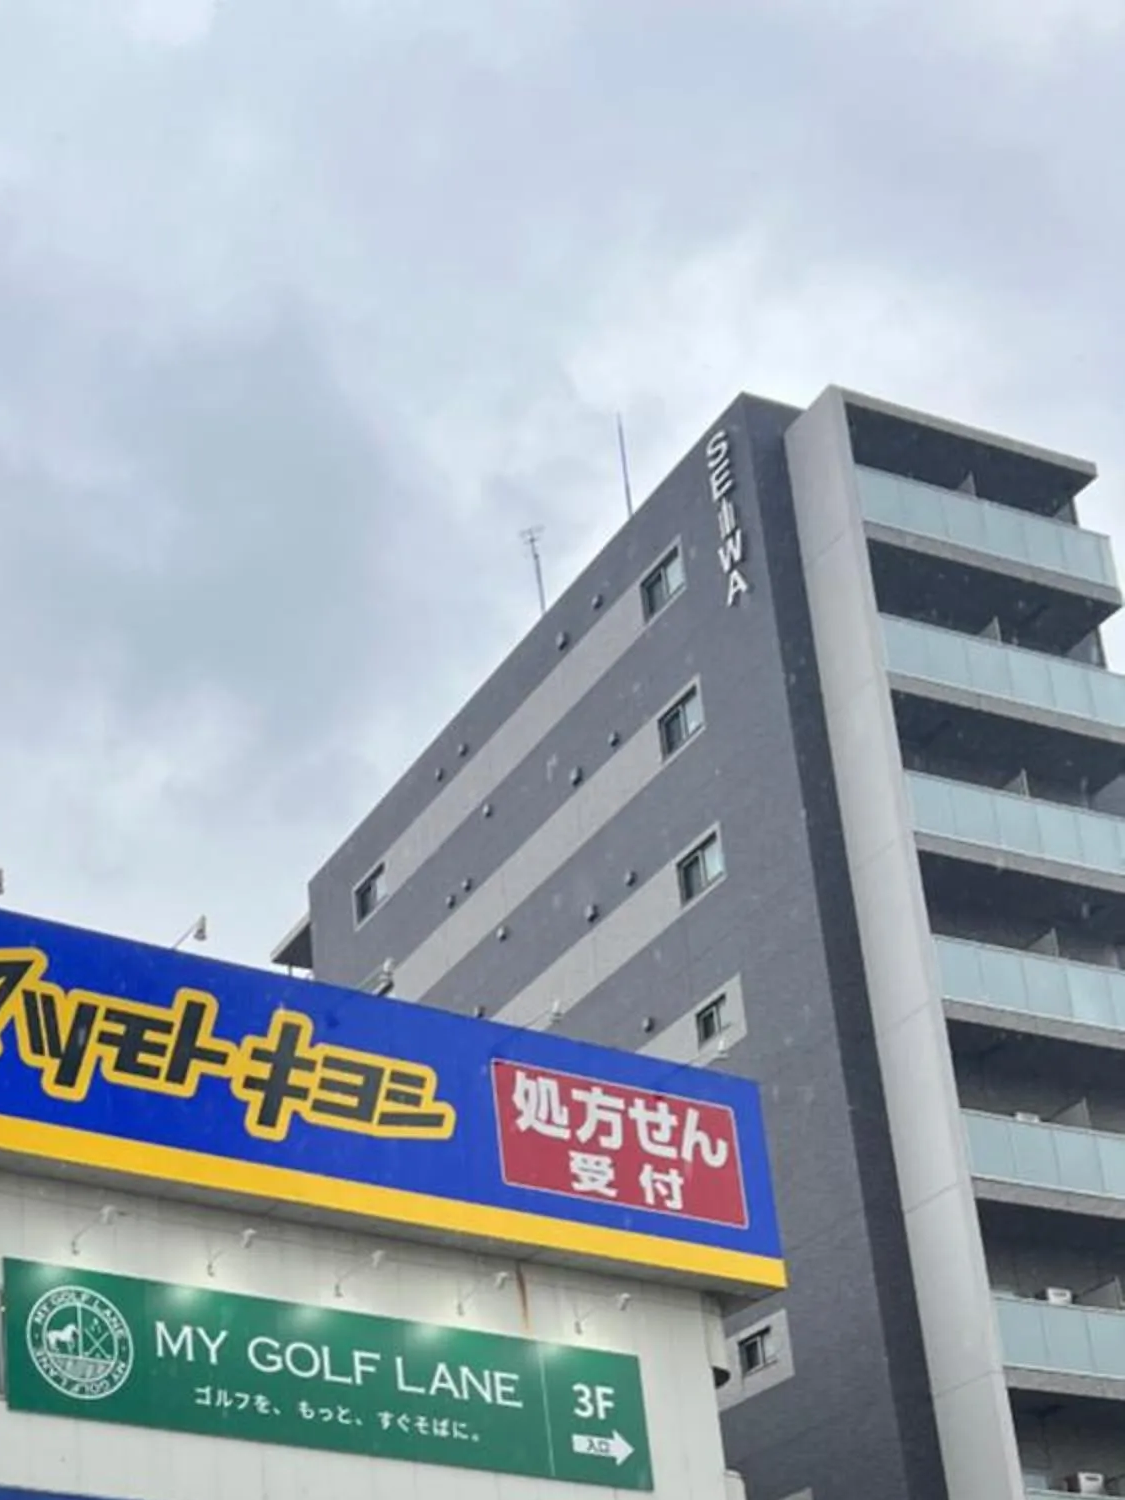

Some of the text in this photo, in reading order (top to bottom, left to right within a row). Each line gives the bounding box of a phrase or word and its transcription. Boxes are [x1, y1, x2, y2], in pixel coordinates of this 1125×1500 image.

[511, 1069, 728, 1168] 処方せん
[569, 1150, 685, 1211] 受付
[154, 1321, 523, 1408] MY GOLF LANE
[572, 1383, 614, 1420] 3F
[587, 1439, 610, 1453] 入口
